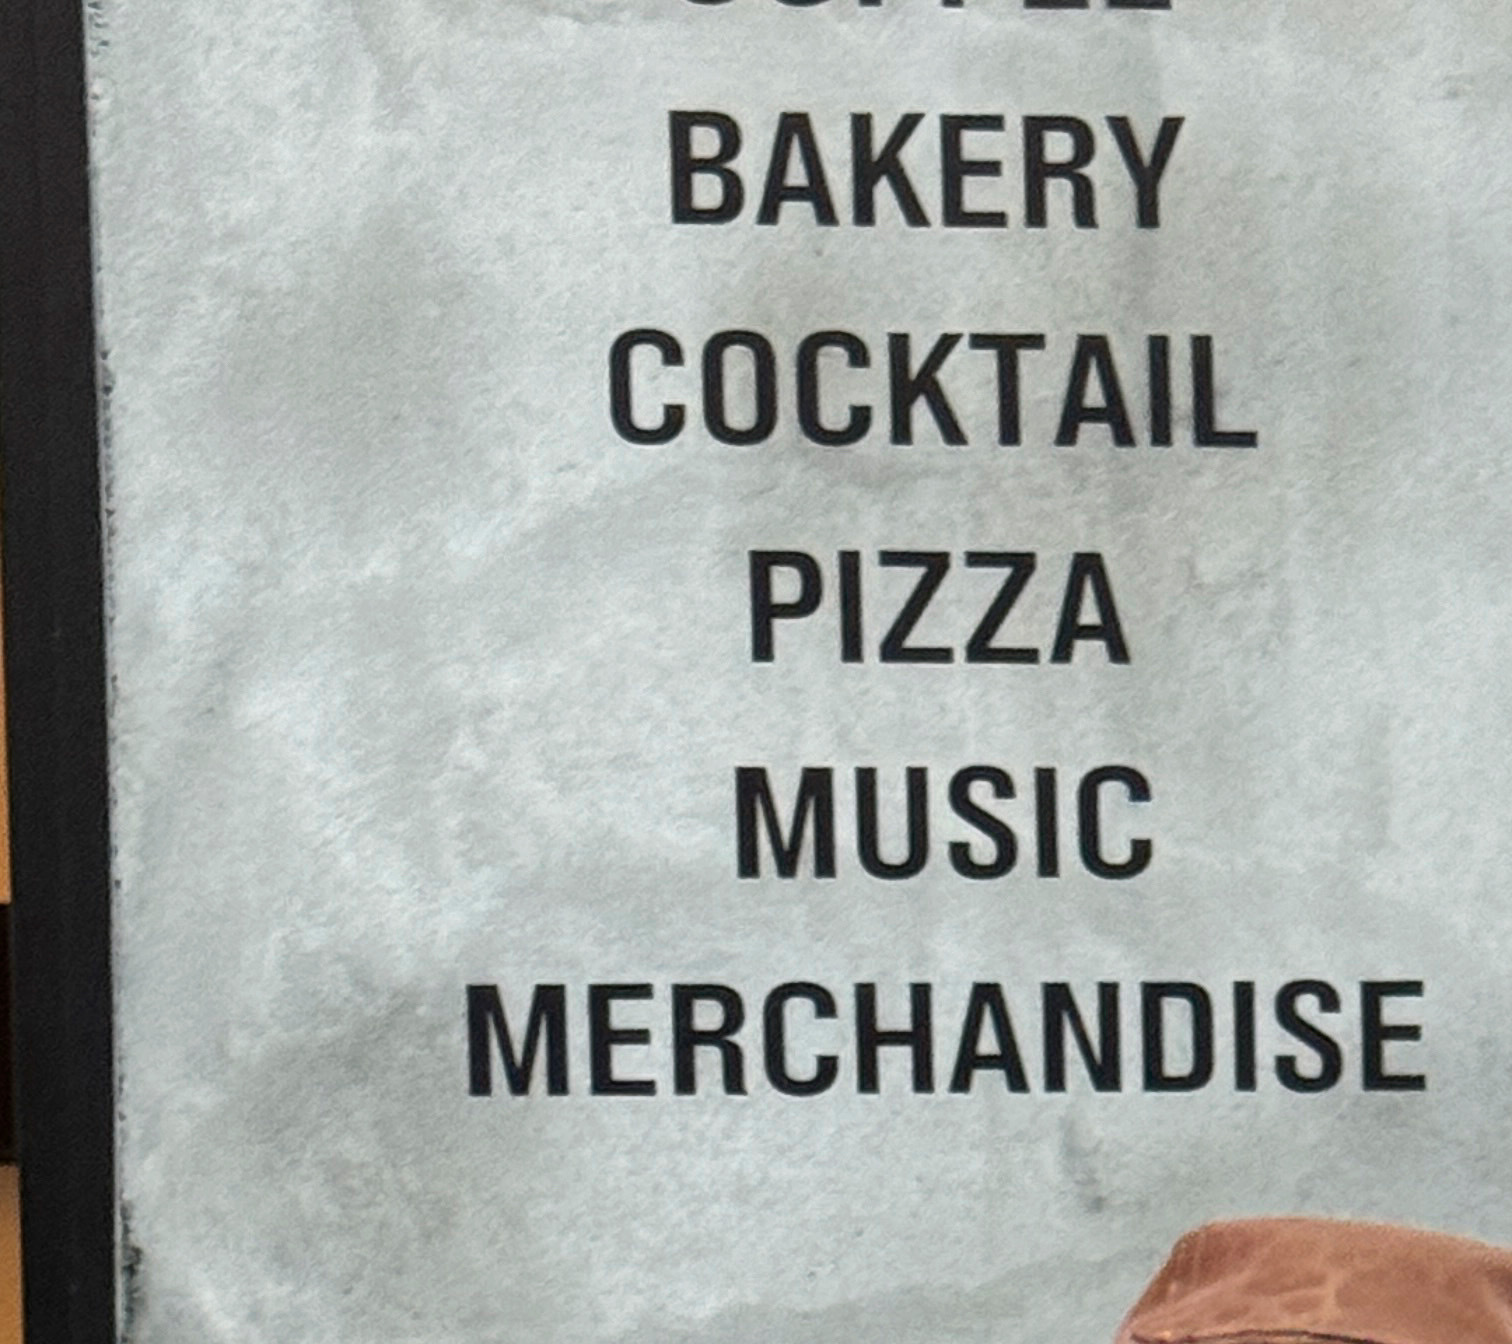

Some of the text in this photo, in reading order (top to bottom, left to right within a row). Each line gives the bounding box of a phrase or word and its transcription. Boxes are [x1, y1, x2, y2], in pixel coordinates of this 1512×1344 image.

[670, 111, 1184, 228] BAKERY
[611, 329, 1257, 447] COCKTAIL
[750, 550, 1130, 663] PIZZA
[736, 766, 1151, 879] MUSIC
[467, 980, 1426, 1097] MERCHANDISE
